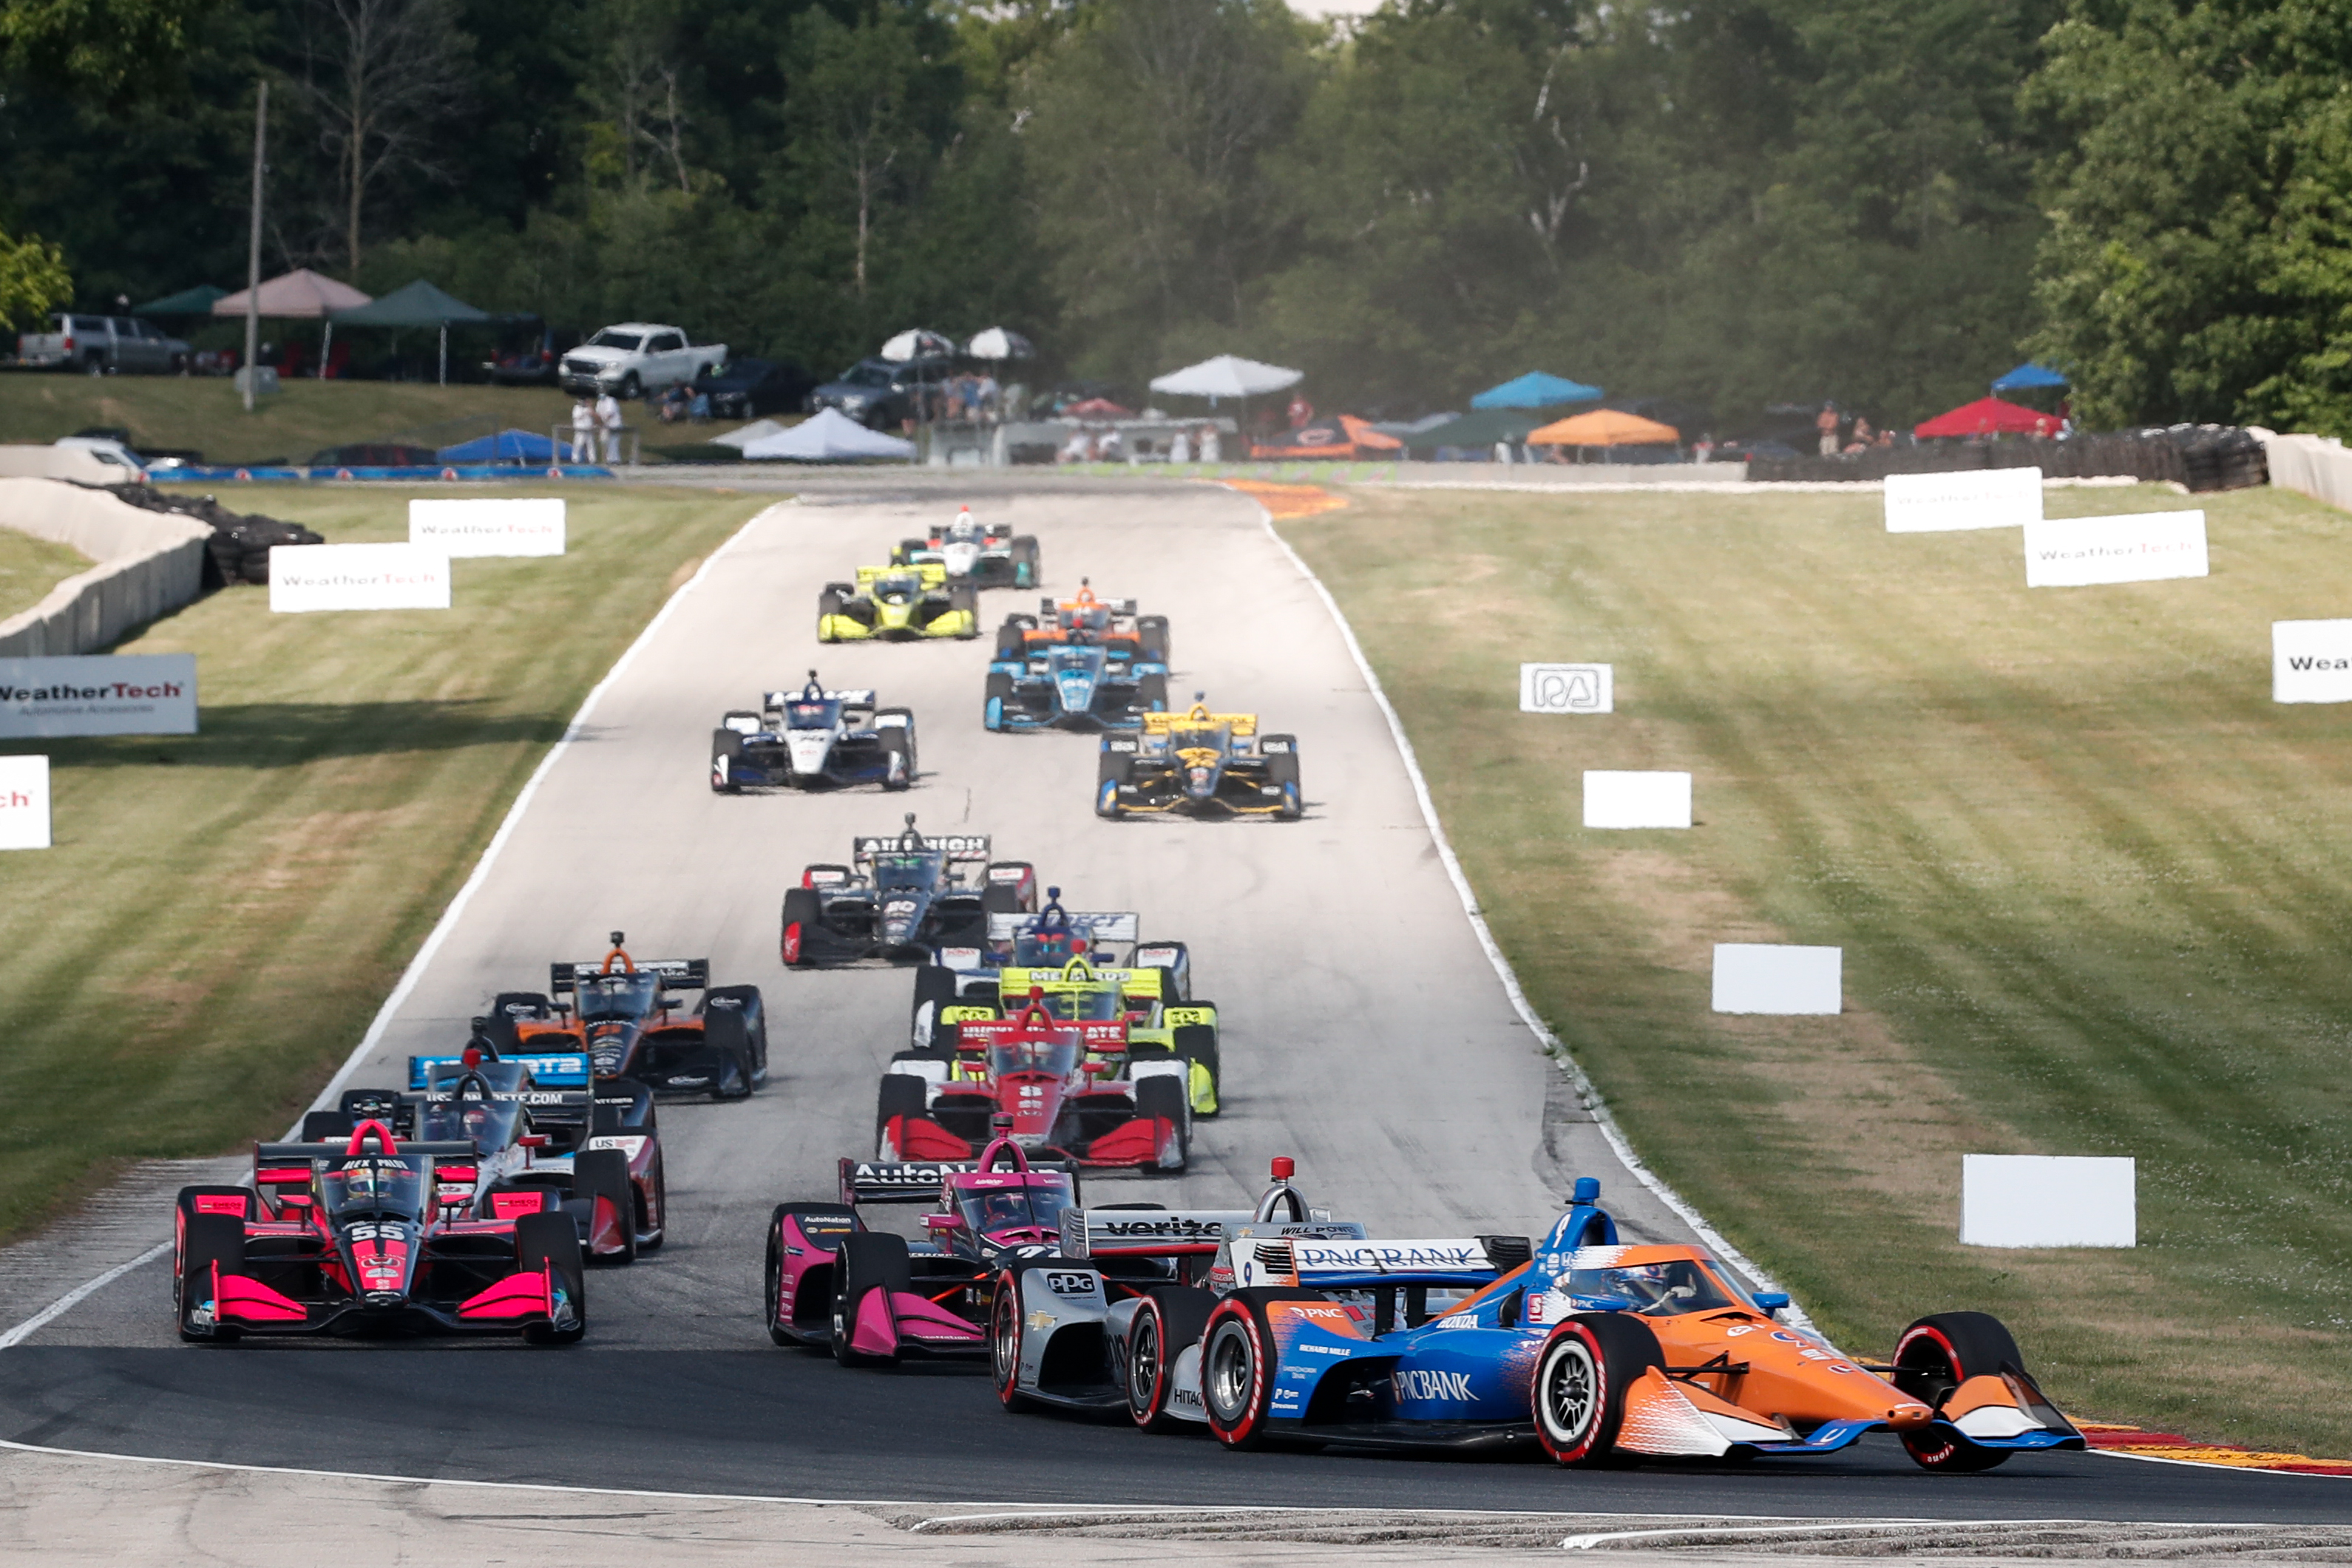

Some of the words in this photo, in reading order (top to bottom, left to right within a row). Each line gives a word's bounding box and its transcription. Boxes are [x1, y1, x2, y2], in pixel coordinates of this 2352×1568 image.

[421, 524, 553, 534] WeatherTech
[2039, 542, 2195, 560] WeatherTech
[282, 573, 435, 587] WeatherTech
[595, 1139, 614, 1147] US
[341, 1158, 370, 1170] ALEX
[804, 1216, 852, 1224] AutoNation
[351, 1225, 405, 1241] 55
[1281, 1226, 1311, 1235] WILL
[1553, 1213, 1572, 1248] 9
[1244, 1261, 1253, 1288] 9
[1048, 1275, 1094, 1292] PPG
[1306, 1308, 1345, 1318] PNC
[1436, 1314, 1478, 1328] HONDA
[1299, 1344, 1329, 1354] RICHARD
[1329, 1347, 1351, 1357] MILLE
[1396, 1370, 1480, 1401] PNCBANK
